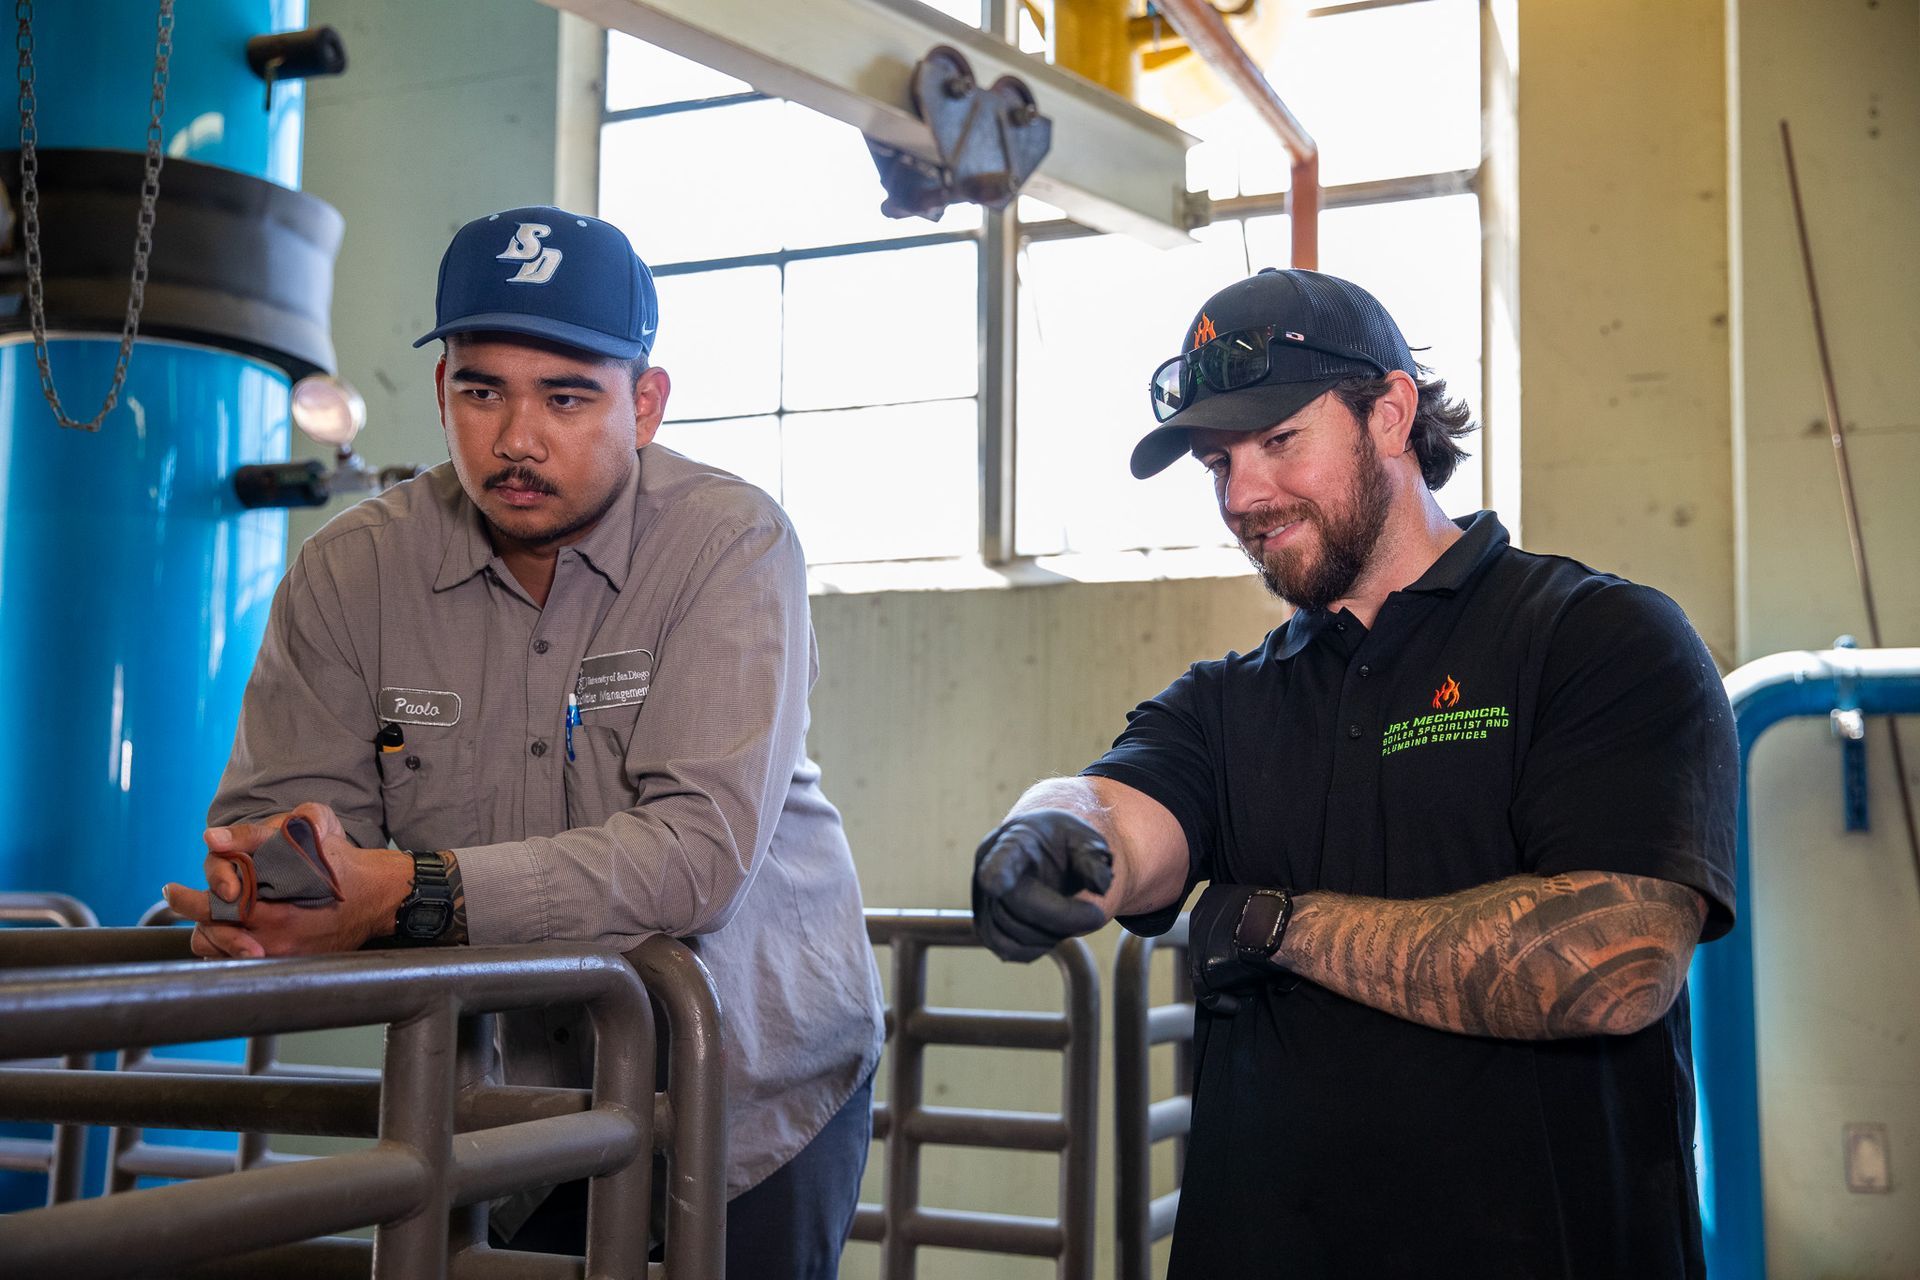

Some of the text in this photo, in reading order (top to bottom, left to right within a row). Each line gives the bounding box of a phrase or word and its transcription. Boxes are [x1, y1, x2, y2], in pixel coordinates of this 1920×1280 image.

[495, 222, 563, 284] SD
[609, 672, 617, 682] of
[628, 670, 650, 680] Diego
[394, 697, 440, 716] Paolo
[1383, 719, 1509, 746] BOILER SPECIALIST AND
[1384, 706, 1509, 736] JAX MECHANICAL
[1382, 730, 1488, 757] PLUMBING SERVICES
